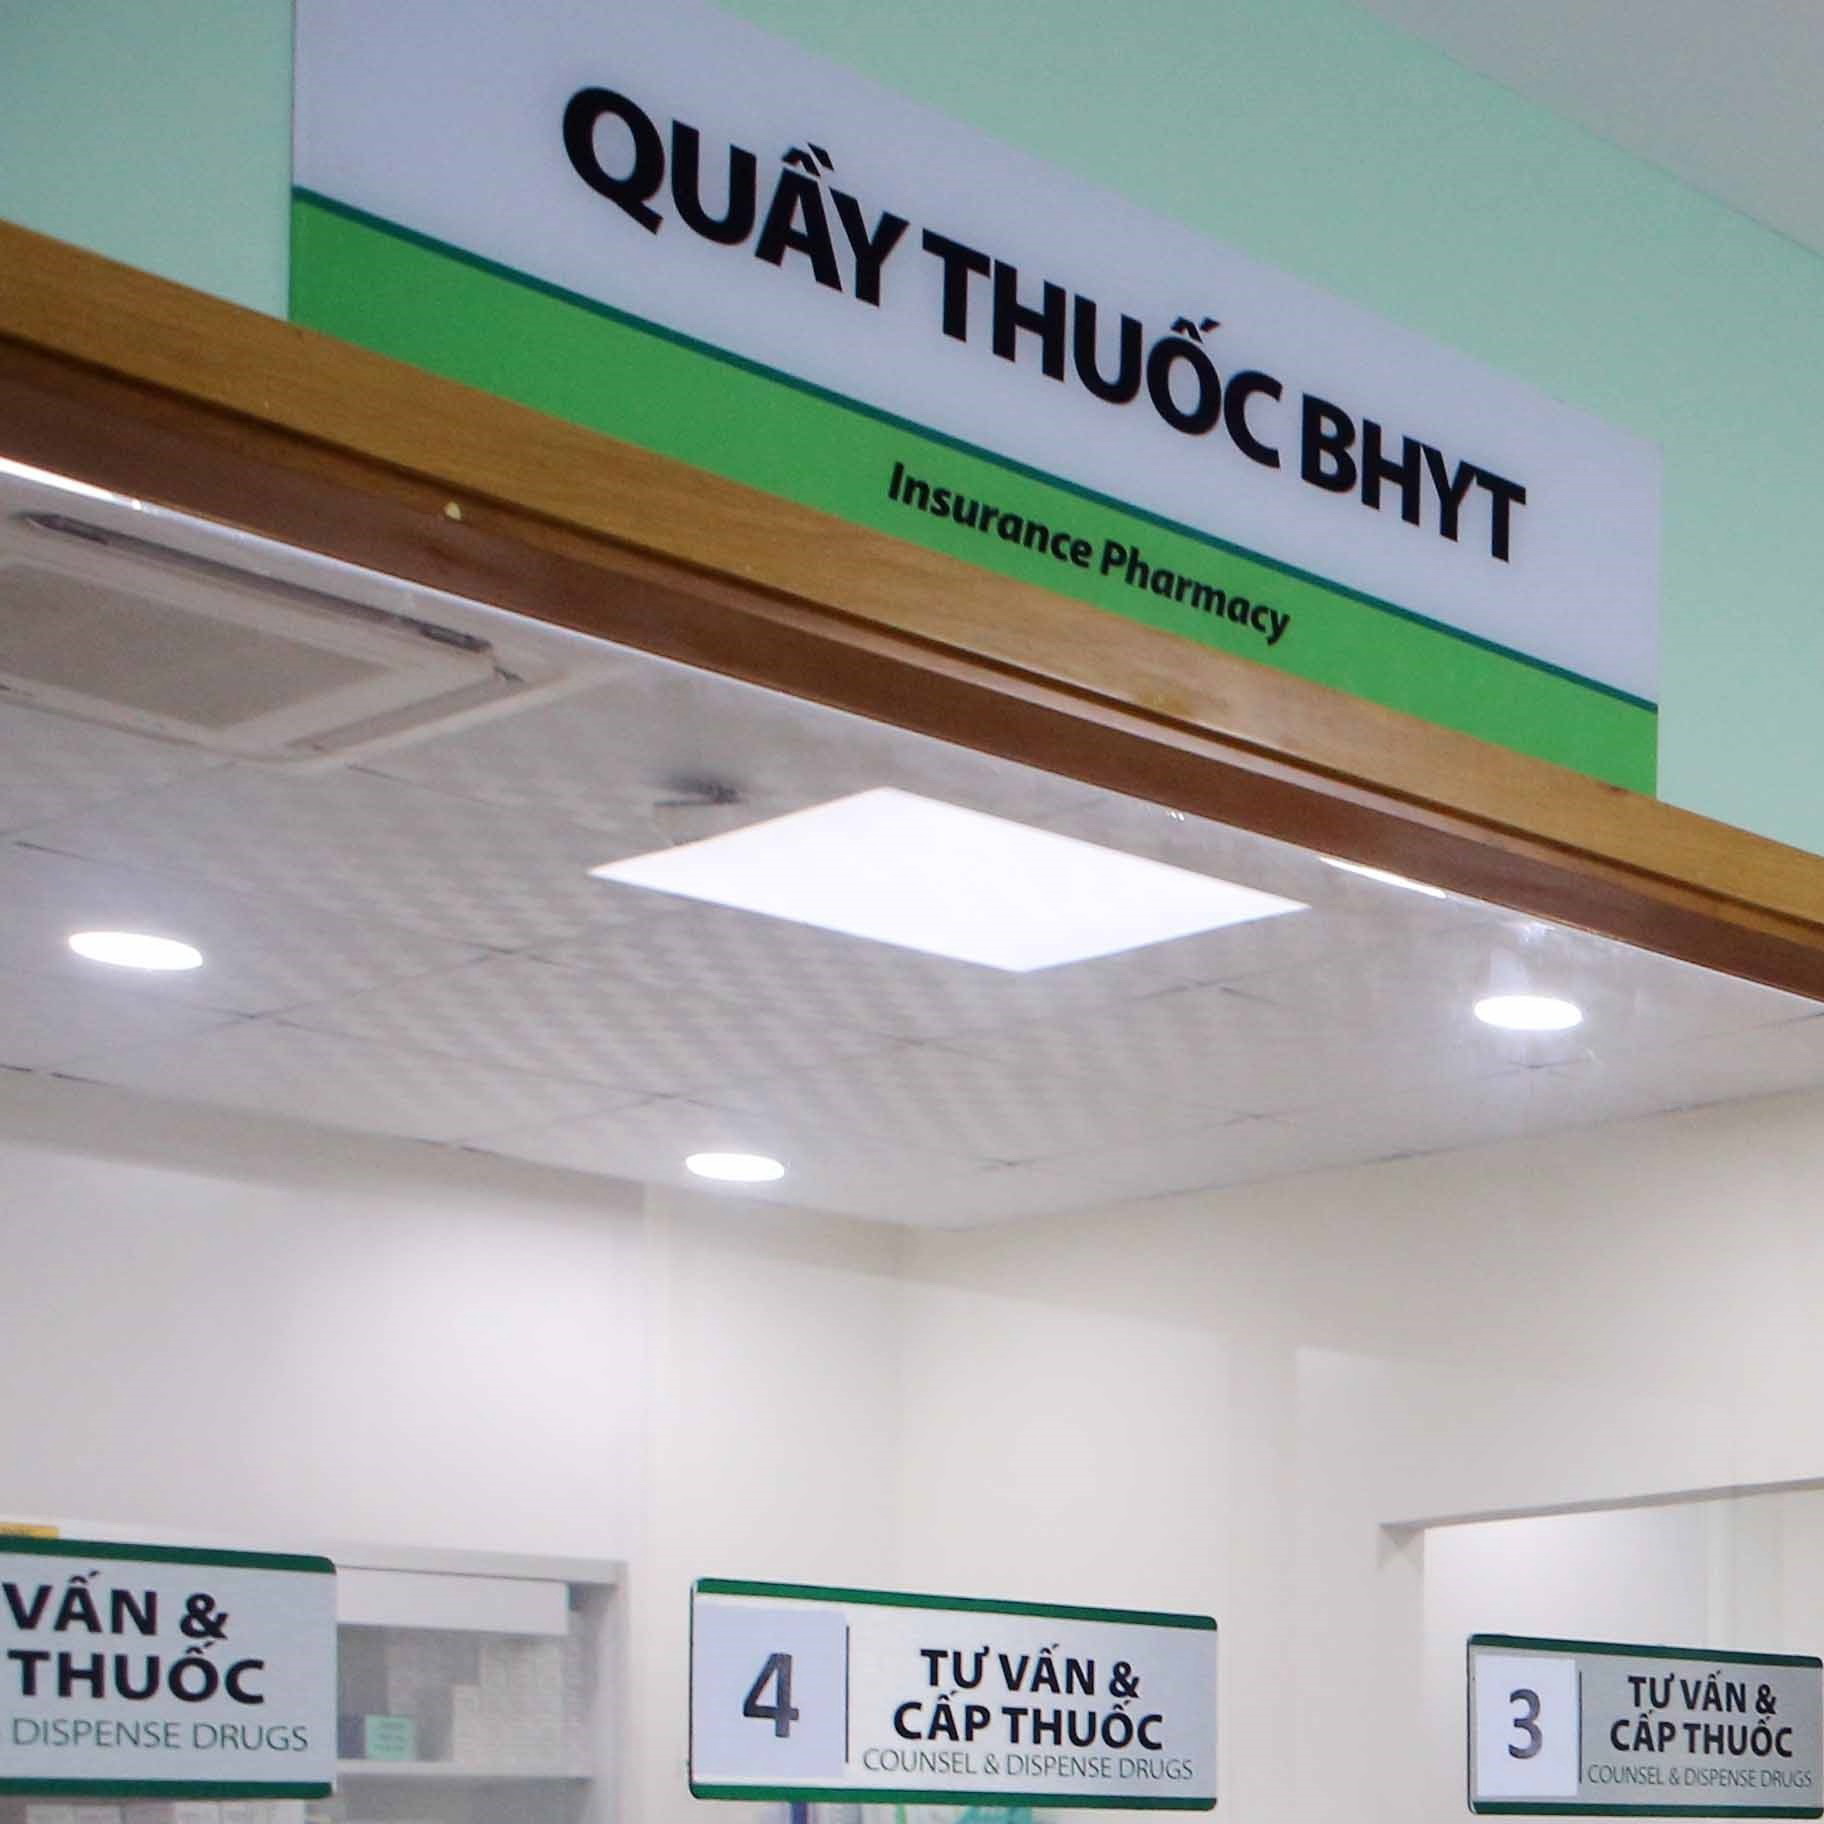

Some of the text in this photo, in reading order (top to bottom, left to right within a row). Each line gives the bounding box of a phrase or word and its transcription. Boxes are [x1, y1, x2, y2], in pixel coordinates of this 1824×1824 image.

[562, 85, 1528, 565] QUẦY THUỐC BHYT
[888, 461, 1291, 643] Insurance Pharmacy
[2, 1569, 228, 1640] VẤN &
[7, 1640, 264, 1705] THUỐC
[742, 1652, 799, 1738] 4
[920, 1643, 1142, 1699] TƯ VẤN &
[1627, 1669, 1777, 1716] TƯ VẤN &
[12, 1717, 309, 1752] DISPENSE DRUGS
[893, 1688, 1164, 1751] CẤP THUỐC
[1508, 1688, 1543, 1760] 3
[1609, 1709, 1793, 1758] CẤP THUỐC
[863, 1747, 1194, 1781] COUNSEL & DISPENSE DRUGS
[1587, 1763, 1813, 1789] COUNSEL & DISPENSE DRUGS
